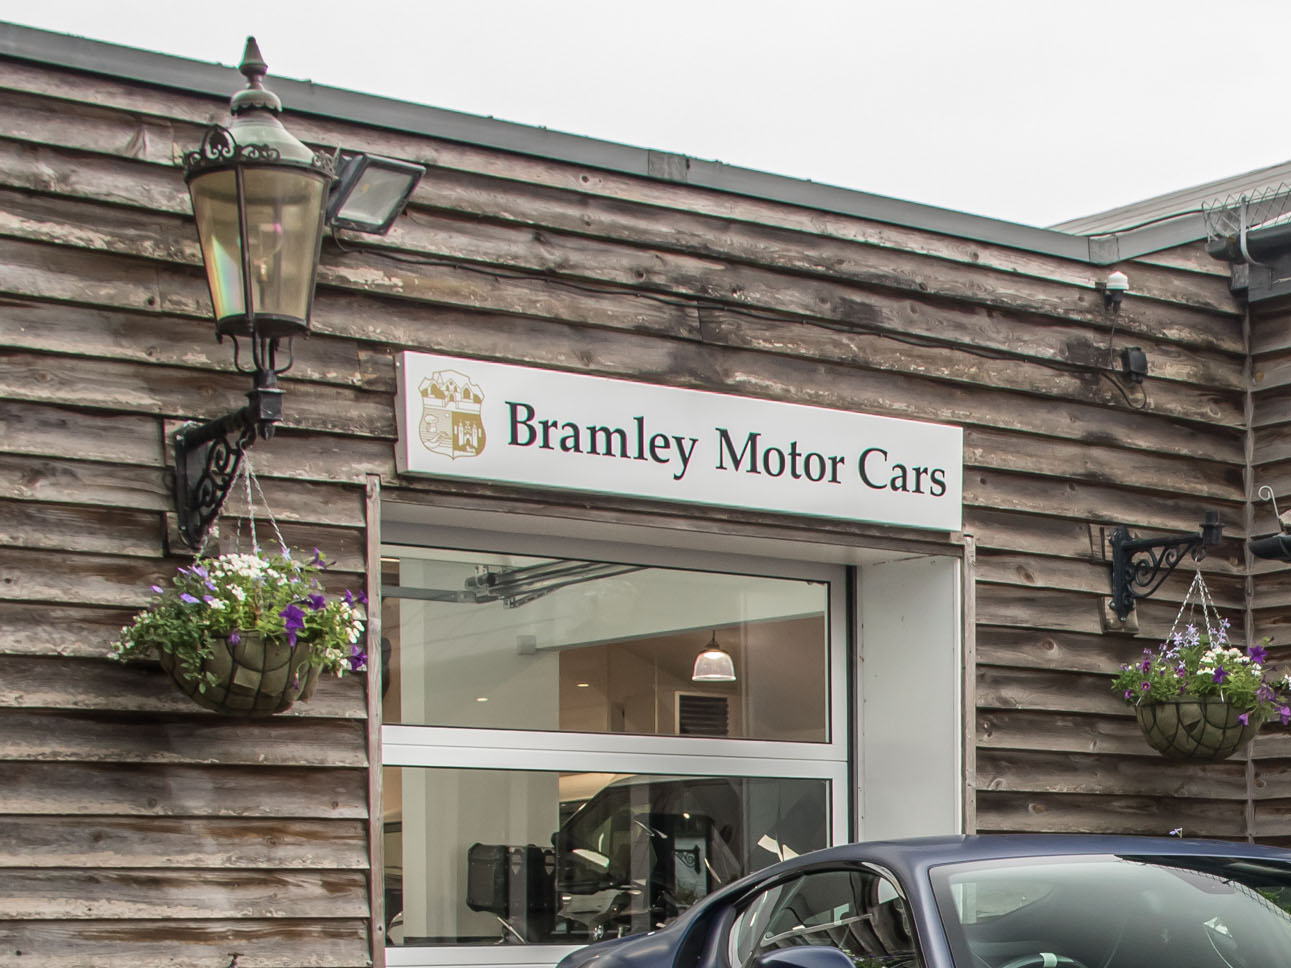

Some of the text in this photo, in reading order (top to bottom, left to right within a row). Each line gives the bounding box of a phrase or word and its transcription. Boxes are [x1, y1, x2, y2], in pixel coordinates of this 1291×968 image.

[504, 400, 947, 497] Bramley Motor Cars
